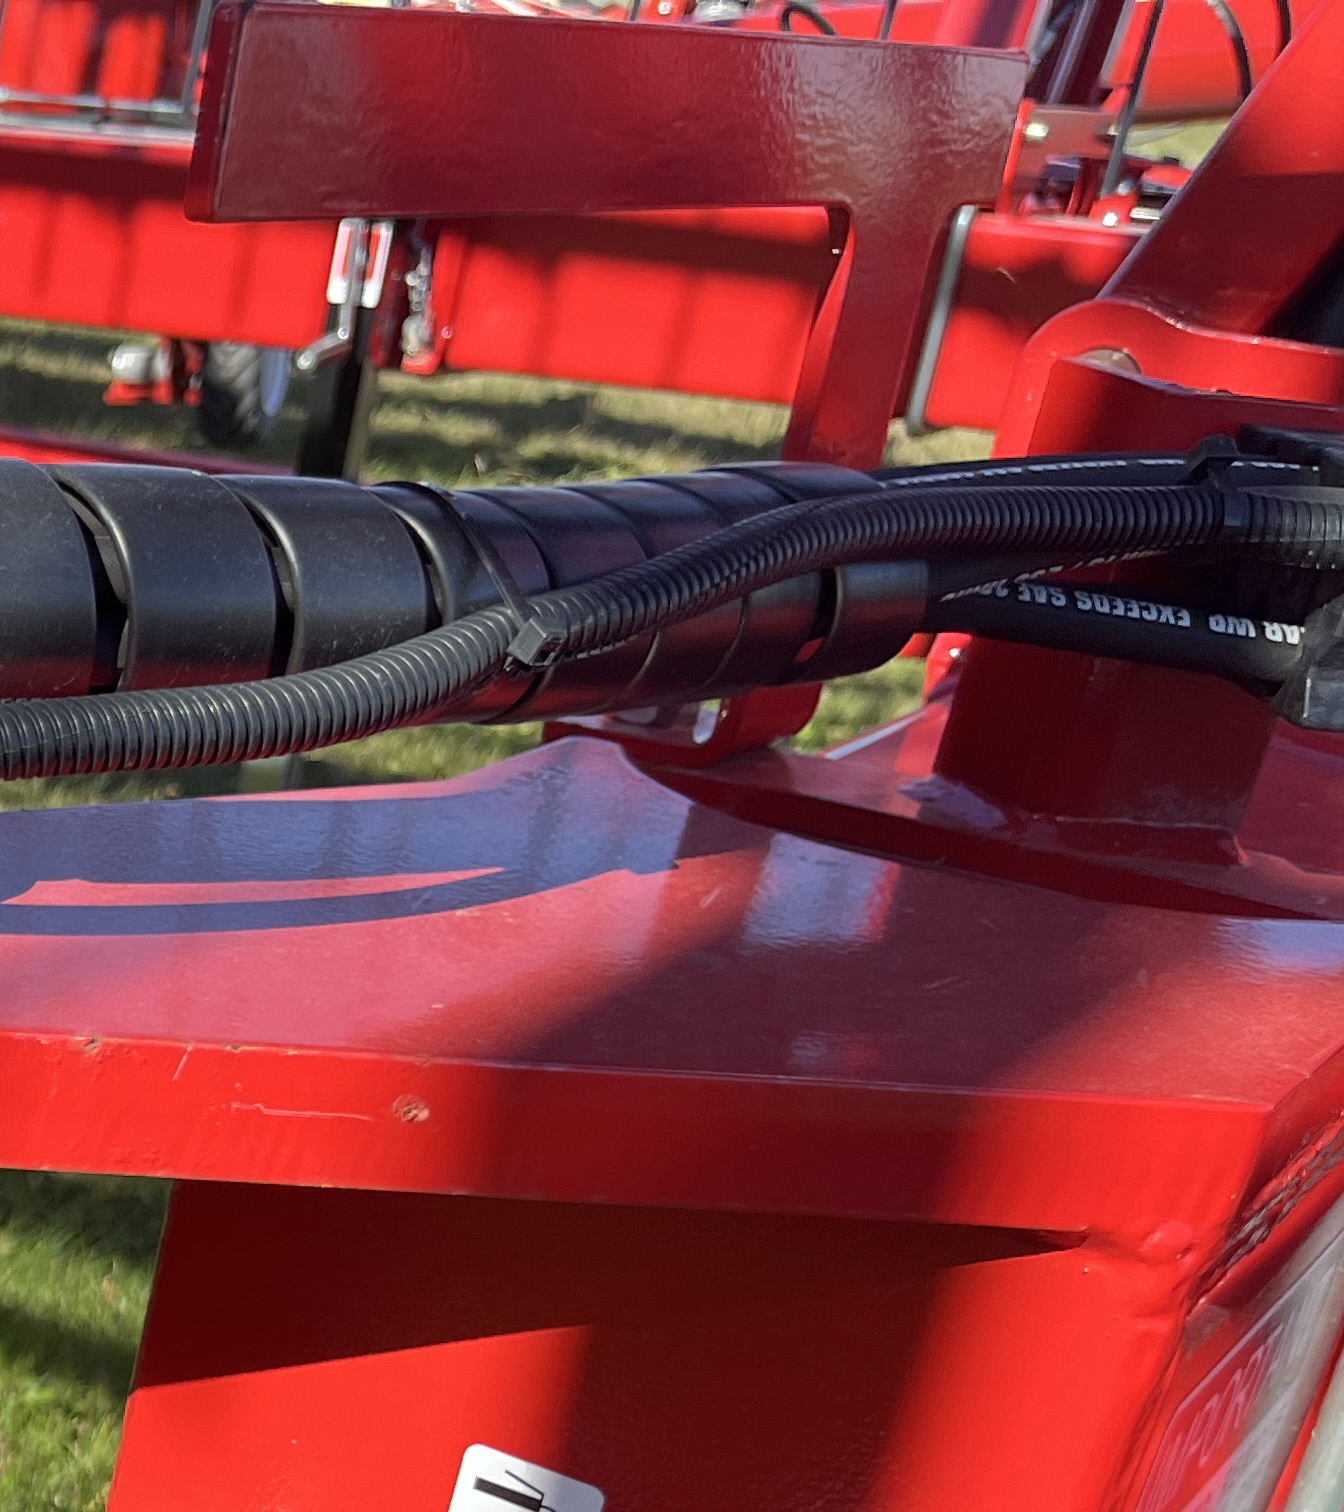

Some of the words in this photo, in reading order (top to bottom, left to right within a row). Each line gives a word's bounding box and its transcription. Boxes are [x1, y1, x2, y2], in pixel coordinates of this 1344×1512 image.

[1017, 582, 1068, 608] SAE
[1074, 590, 1192, 629] EXCEEDS
[1261, 620, 1306, 645] AR
